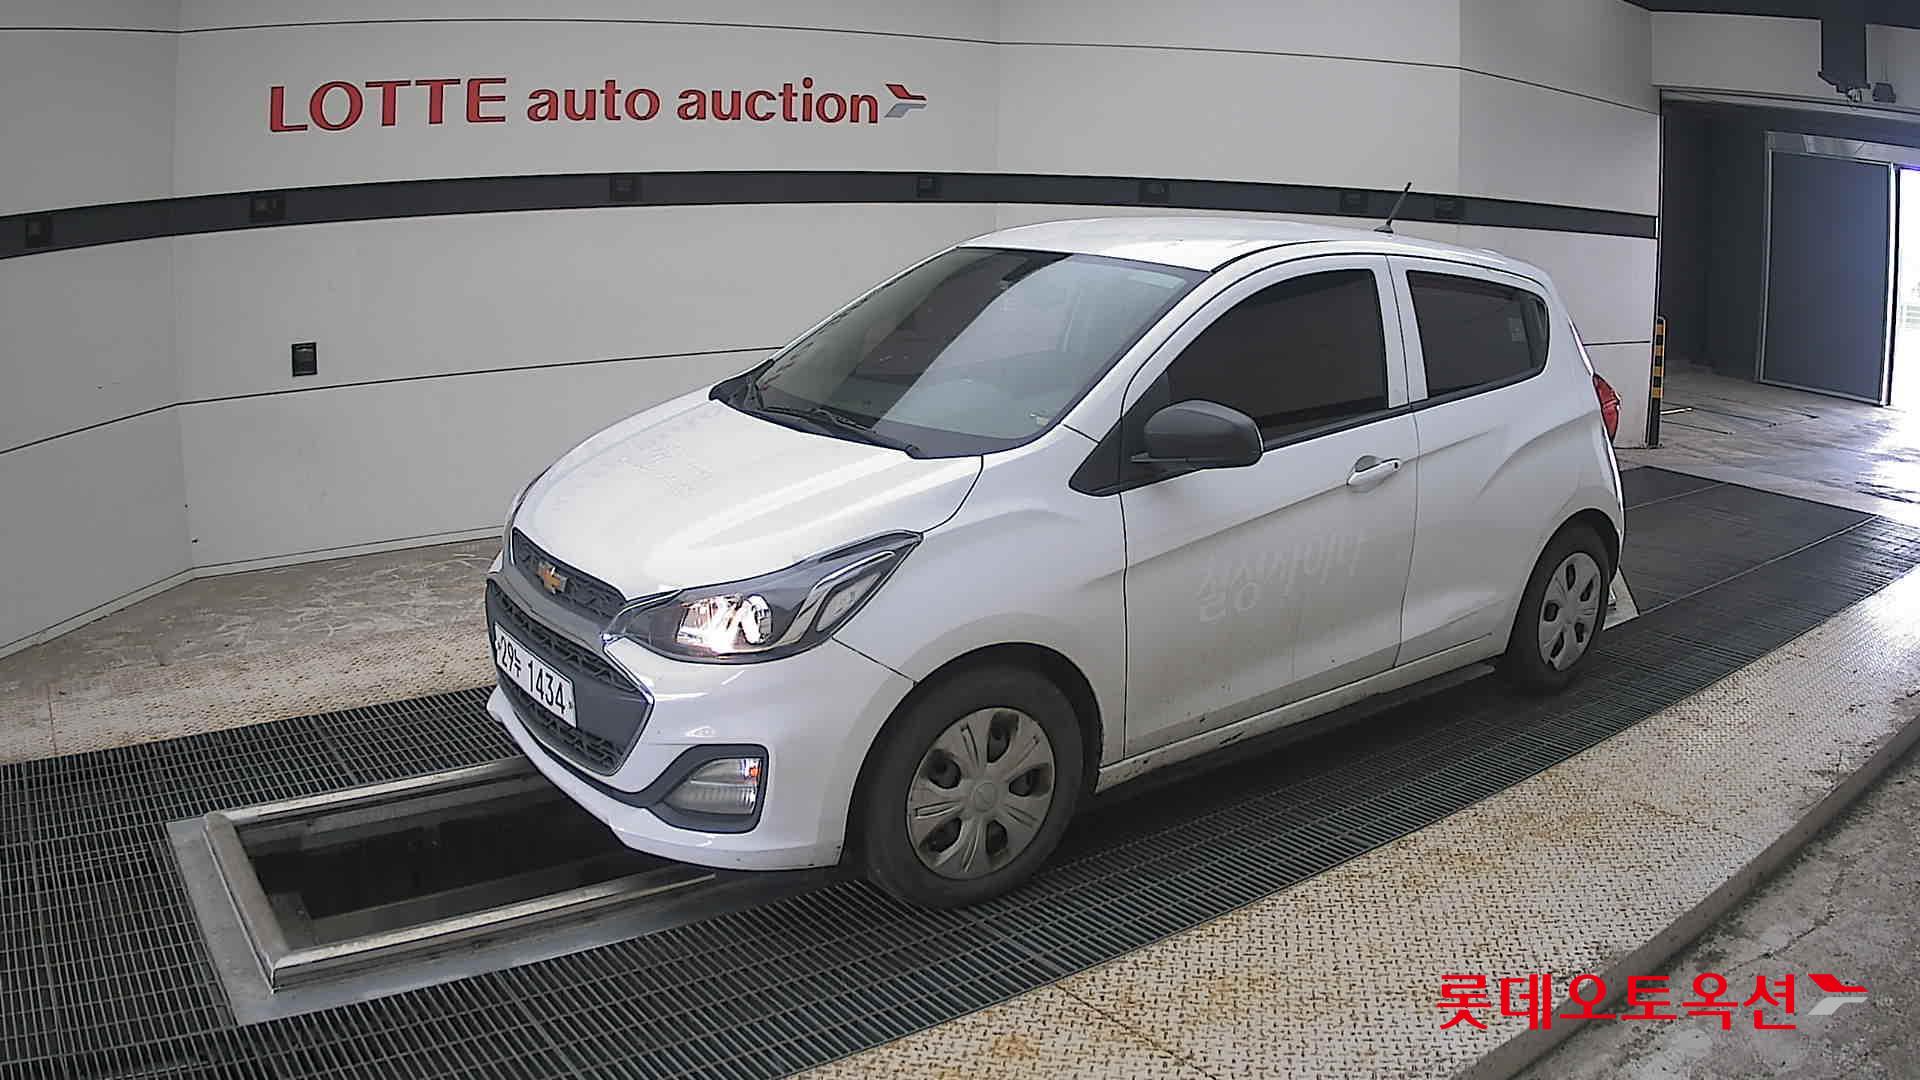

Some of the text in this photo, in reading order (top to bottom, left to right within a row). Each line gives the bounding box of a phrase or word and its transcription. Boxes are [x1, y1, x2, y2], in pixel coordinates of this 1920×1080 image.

[269, 77, 879, 132] LOTTE auto auction
[527, 660, 566, 714] 1434
